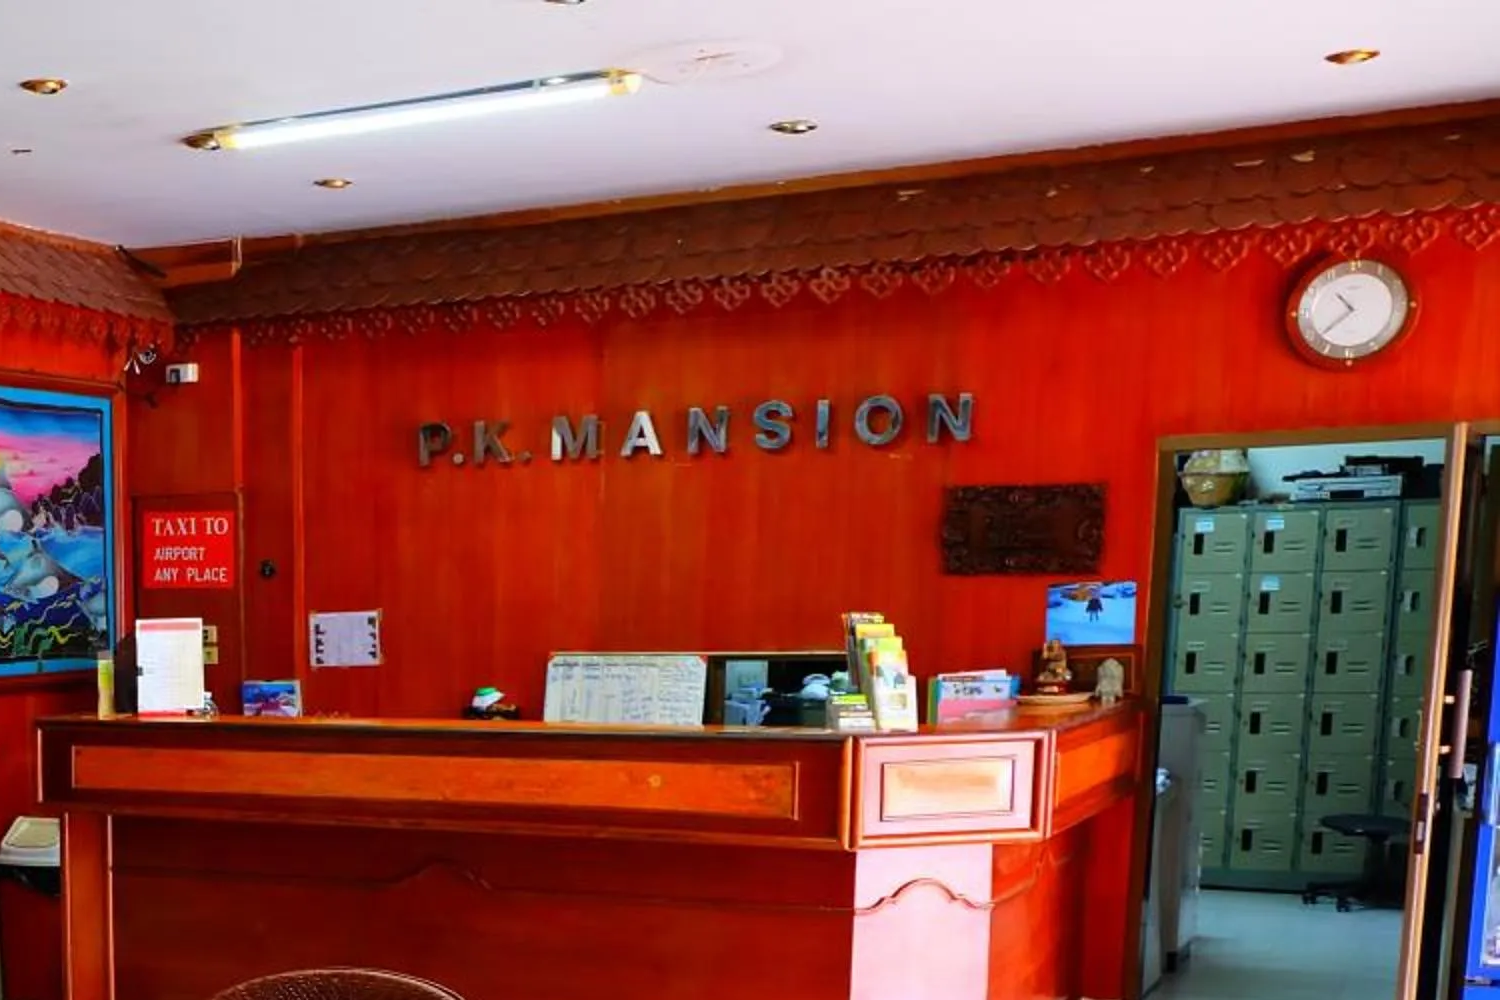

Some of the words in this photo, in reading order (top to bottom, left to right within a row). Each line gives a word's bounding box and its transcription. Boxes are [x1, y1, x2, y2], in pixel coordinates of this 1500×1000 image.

[550, 393, 974, 461] MANSION
[151, 516, 197, 537] TAXI
[203, 516, 230, 536] TO
[153, 546, 206, 562] AIRPORT
[153, 566, 180, 583] ANY
[186, 566, 229, 584] PLACE
